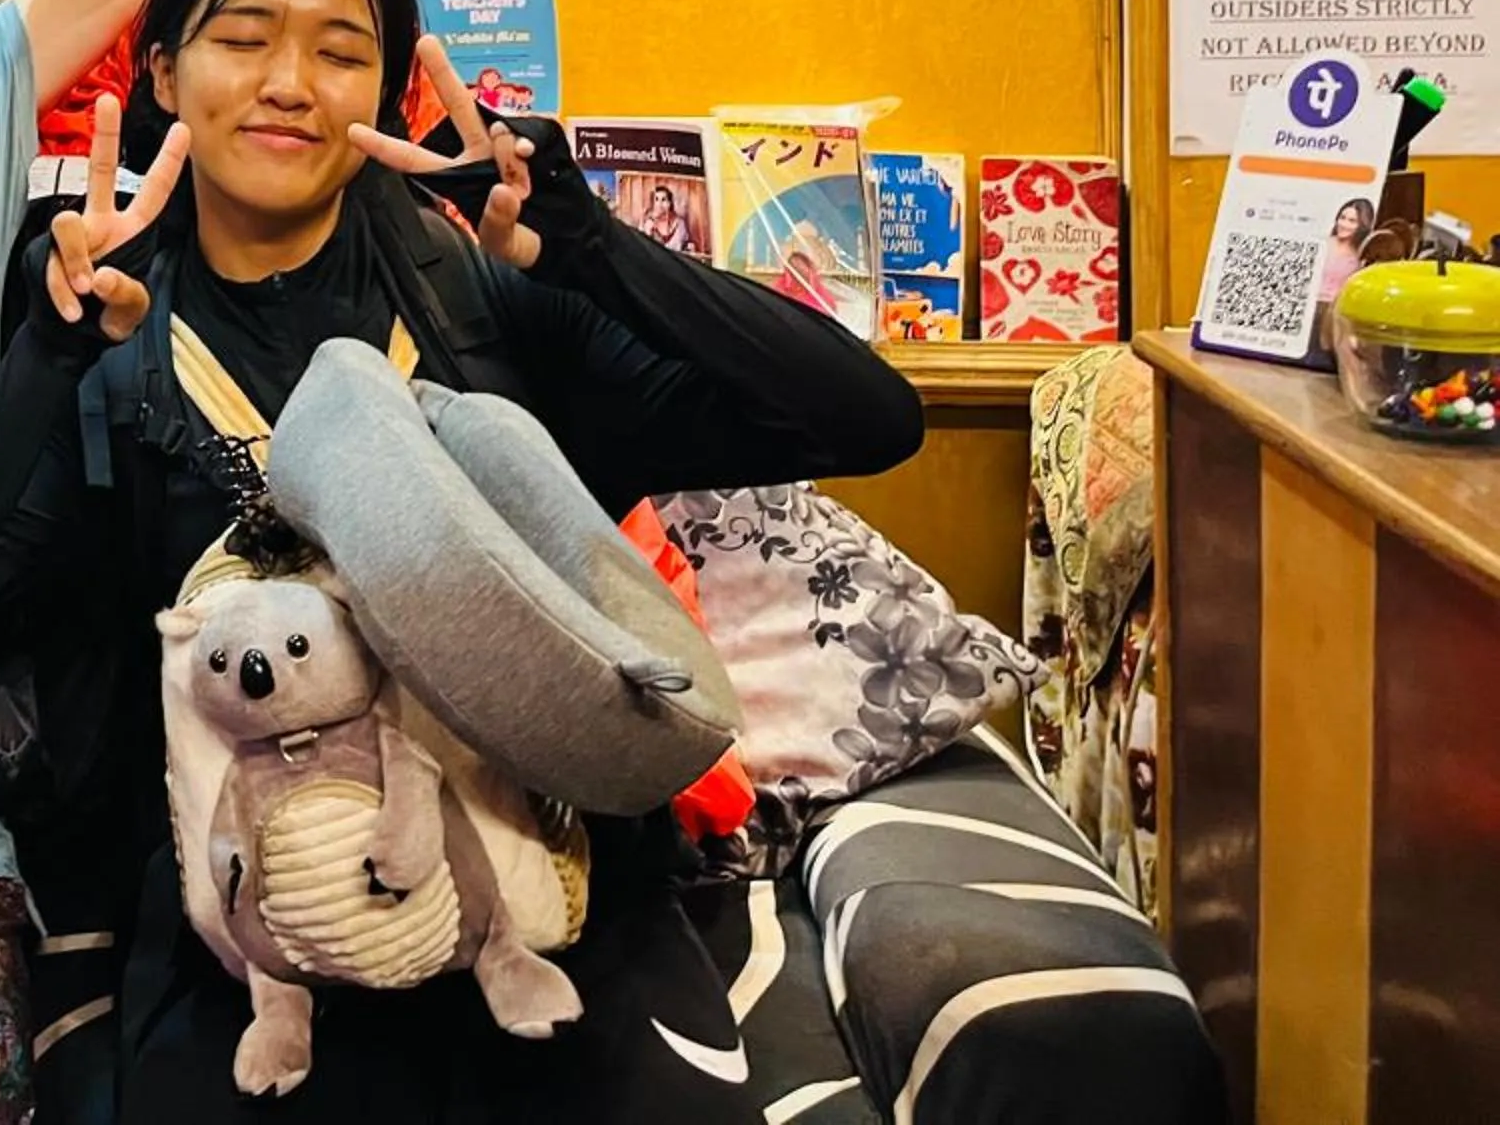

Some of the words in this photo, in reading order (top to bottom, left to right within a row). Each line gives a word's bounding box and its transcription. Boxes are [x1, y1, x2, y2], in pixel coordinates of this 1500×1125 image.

[469, 8, 501, 25] DAY
[1201, 37, 1248, 56] NOT
[1256, 35, 1377, 55] ALLOWED
[1385, 33, 1486, 53] BEYOND
[1307, 67, 1342, 119] पे
[1274, 130, 1349, 153] PhonePe
[577, 142, 592, 159] A
[659, 146, 701, 168] Woman
[1007, 220, 1046, 244] Love
[1052, 219, 1102, 251] Story
